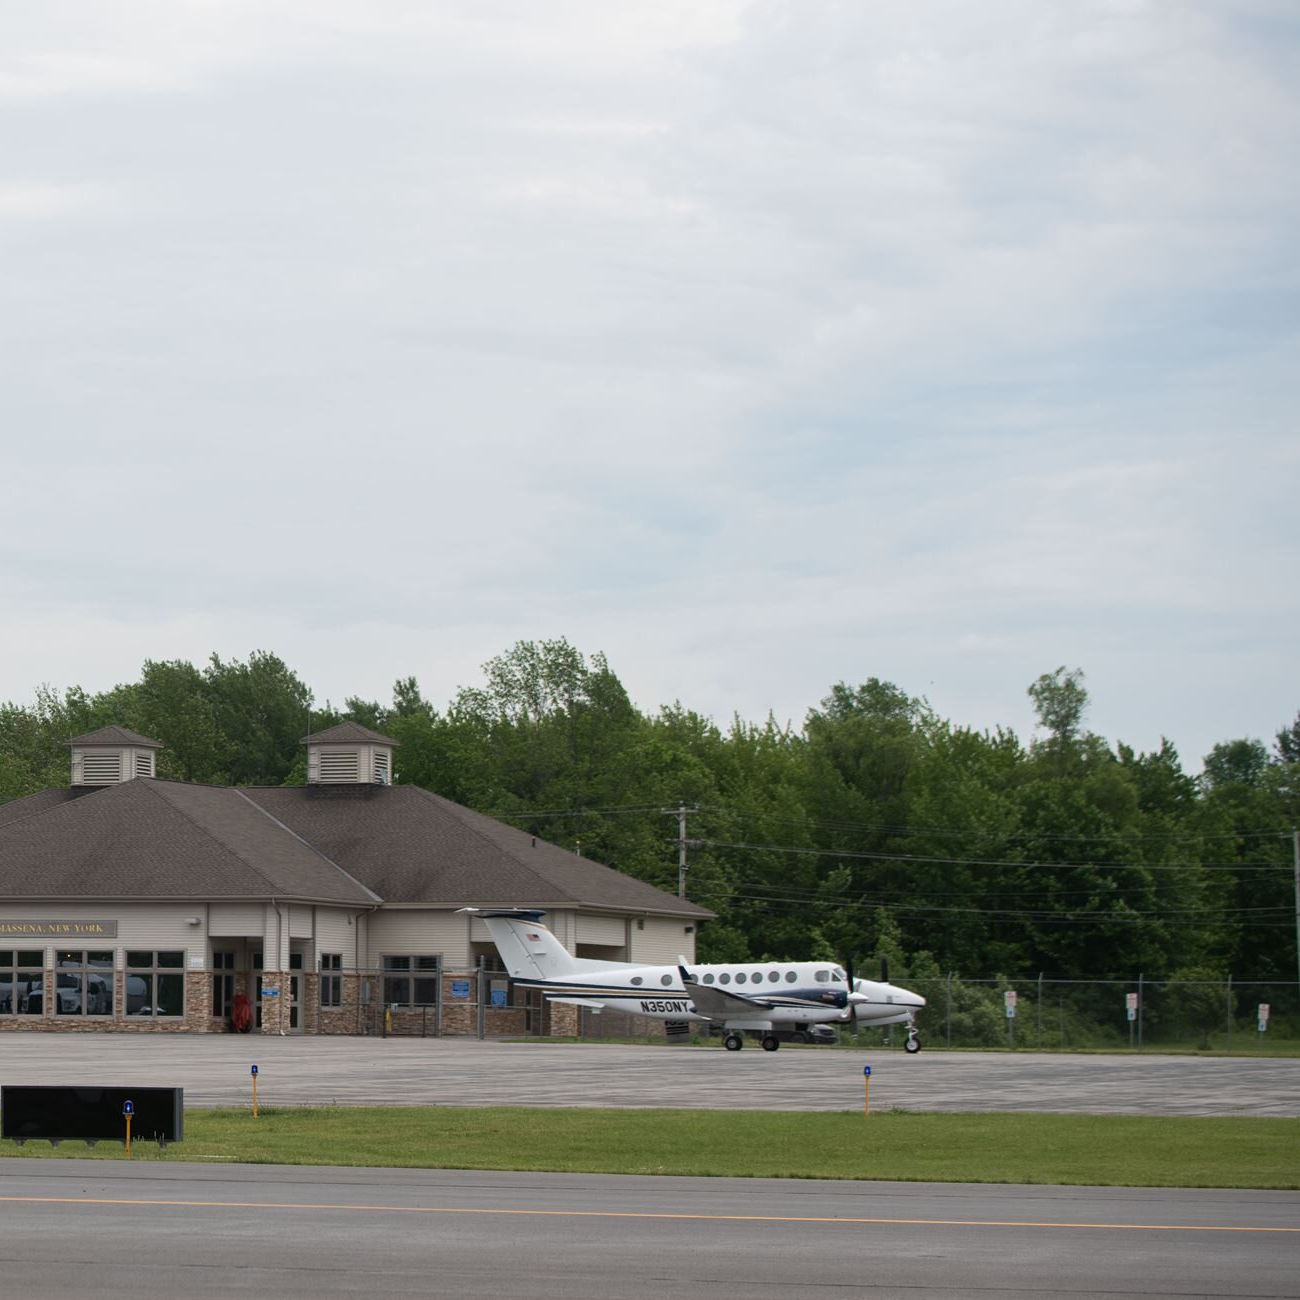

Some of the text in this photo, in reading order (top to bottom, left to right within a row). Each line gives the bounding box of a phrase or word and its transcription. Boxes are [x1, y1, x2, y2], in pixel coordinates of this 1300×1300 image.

[49, 924, 70, 932] NEW
[74, 924, 102, 932] YORK
[640, 1001, 688, 1013] N350NY
